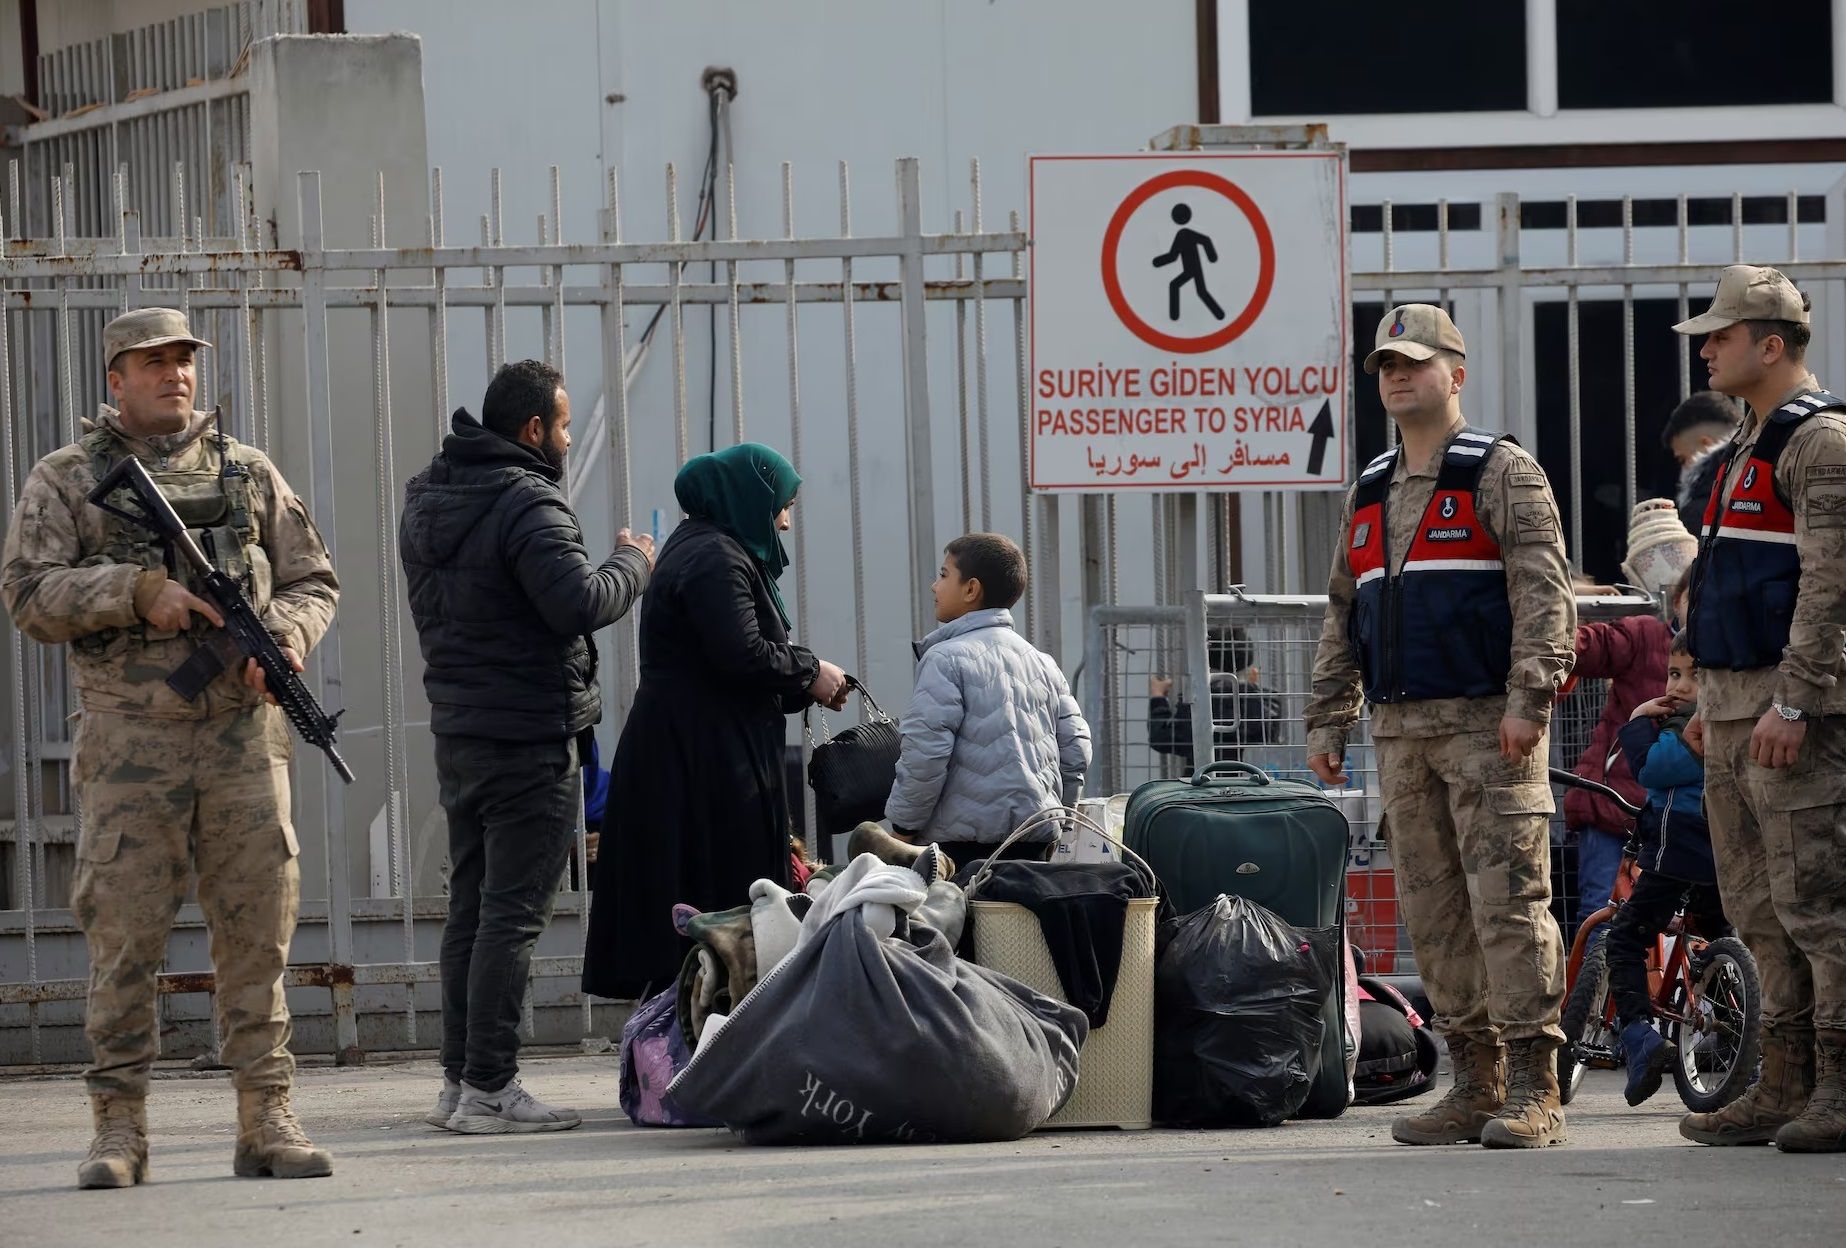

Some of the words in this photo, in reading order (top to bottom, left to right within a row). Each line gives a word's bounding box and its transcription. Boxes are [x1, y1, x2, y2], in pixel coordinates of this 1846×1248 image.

[1038, 362, 1141, 398] SURİYE
[1150, 361, 1235, 397] GİDEN
[1245, 366, 1338, 397] YOLCU
[1038, 408, 1186, 436] PASSENGER
[1194, 407, 1226, 433] TO
[1233, 406, 1305, 433] SYRIA
[1087, 446, 1161, 476] سوريا
[1170, 443, 1207, 479] إلى
[1218, 439, 1291, 474] مسافر
[1731, 501, 1762, 512] JANDARMA
[1428, 528, 1468, 540] JANDARMA
[798, 1070, 874, 1138] York
